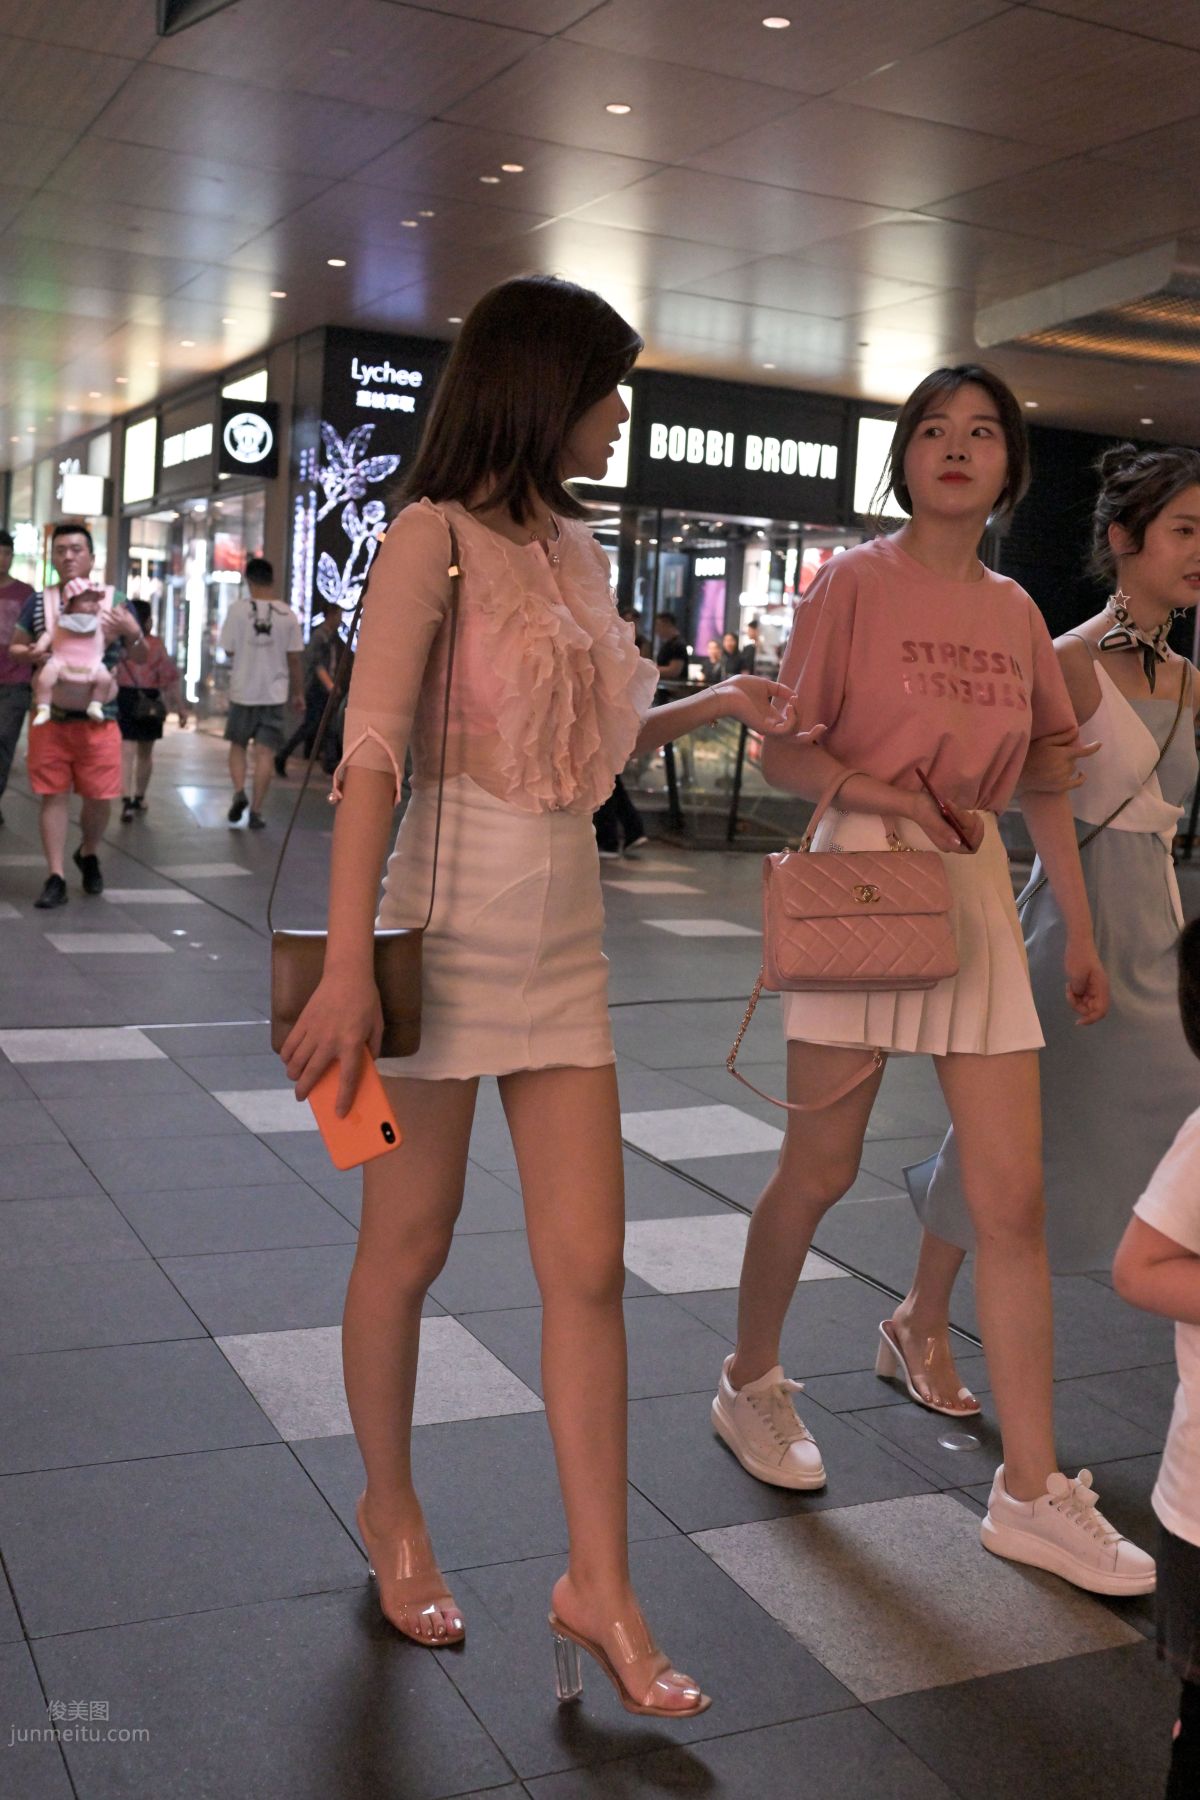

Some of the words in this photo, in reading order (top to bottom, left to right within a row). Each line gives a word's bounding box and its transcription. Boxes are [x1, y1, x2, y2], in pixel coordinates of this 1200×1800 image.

[351, 357, 423, 388] Lychee
[650, 423, 735, 468] BOBBI
[745, 435, 838, 480] BROWN
